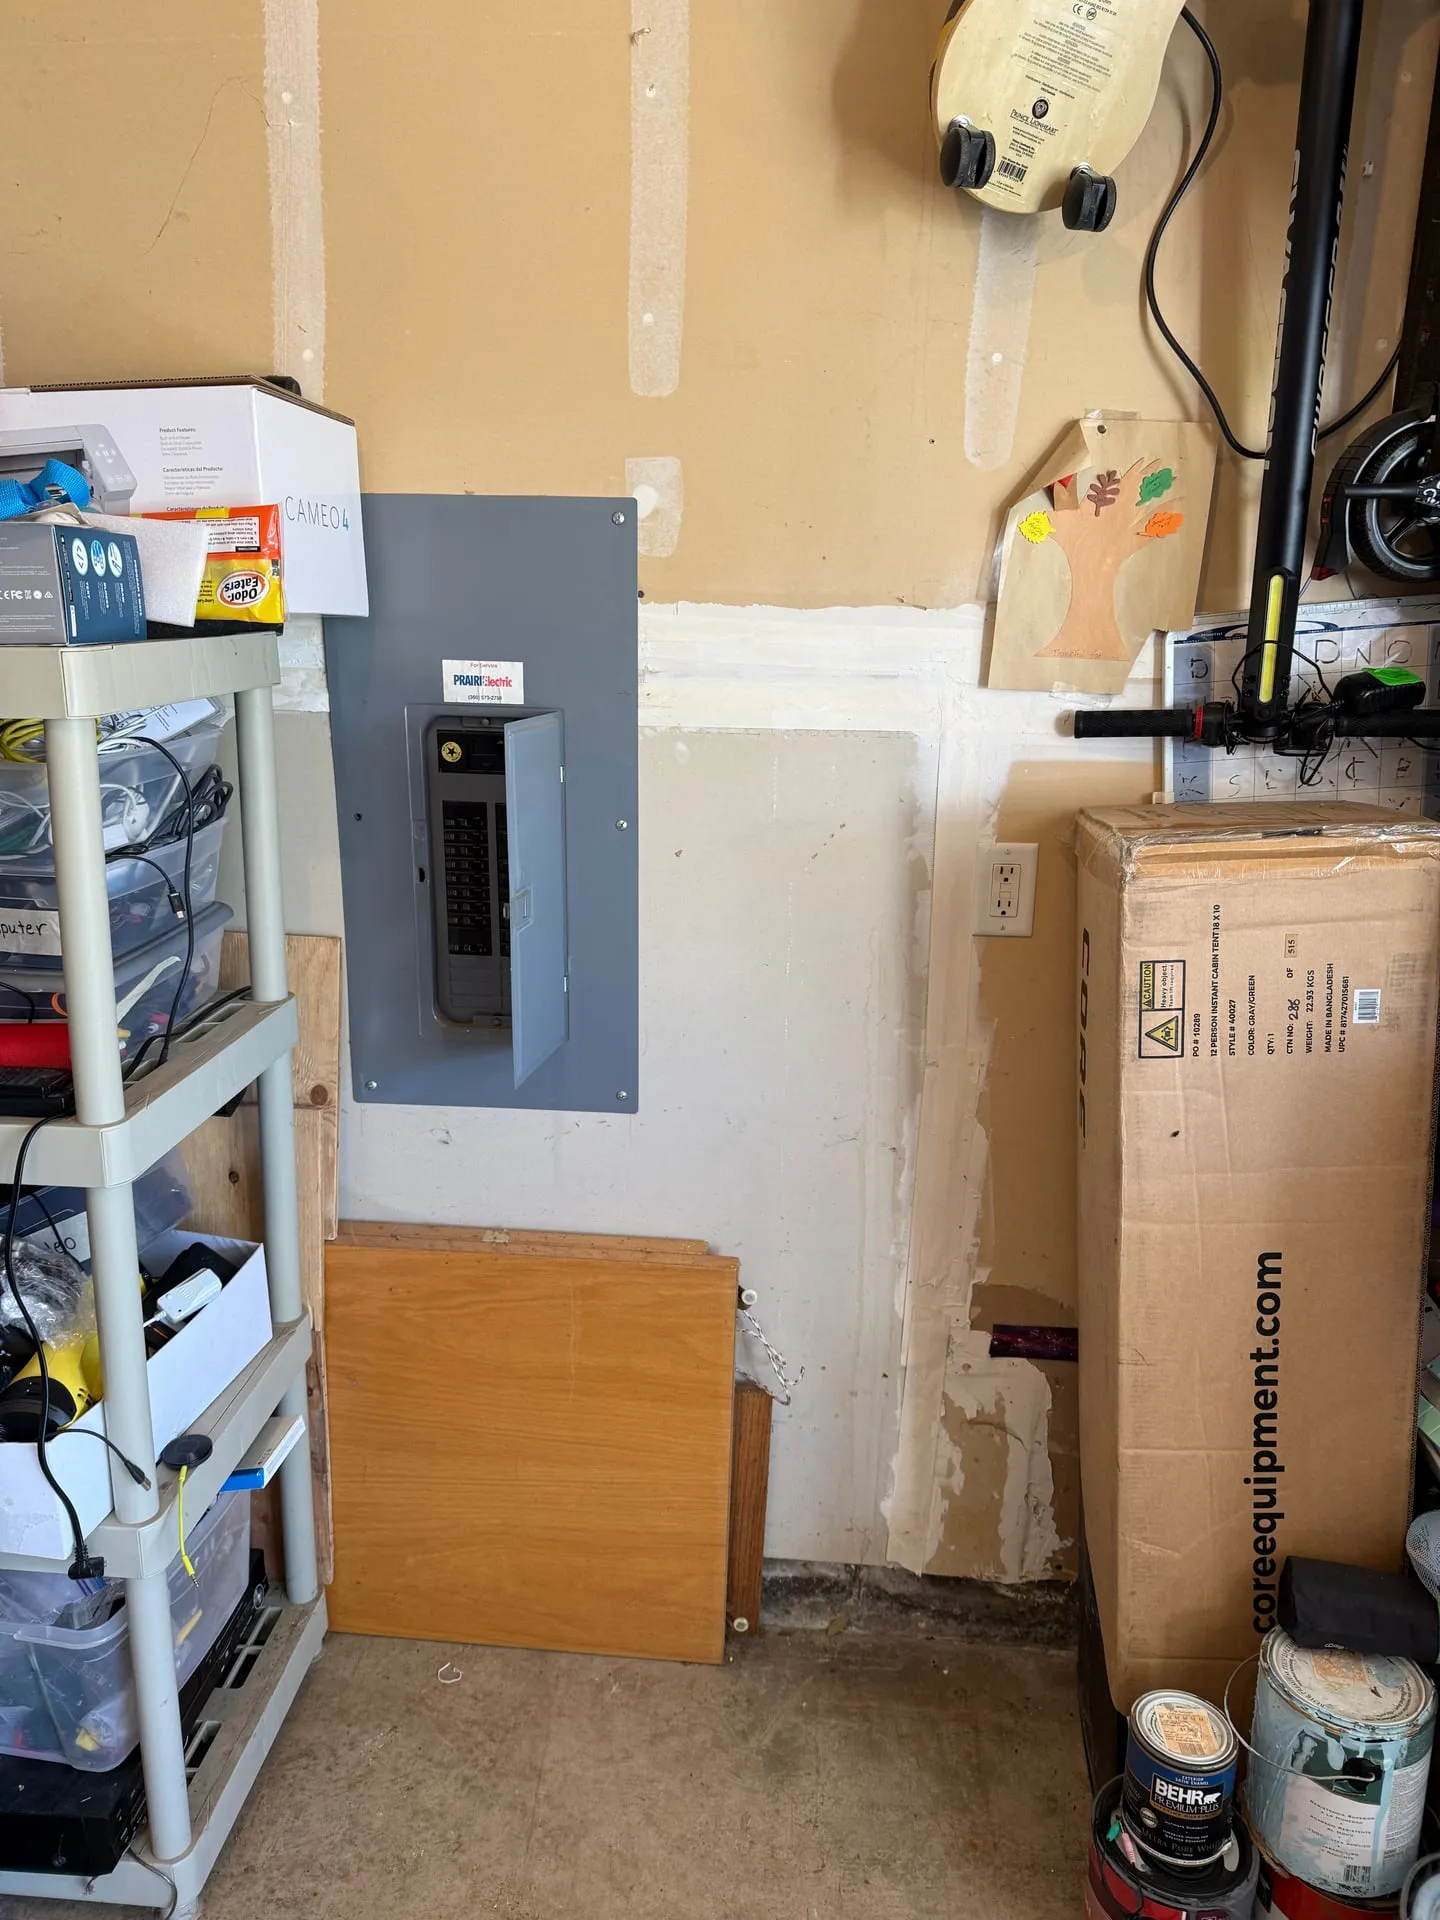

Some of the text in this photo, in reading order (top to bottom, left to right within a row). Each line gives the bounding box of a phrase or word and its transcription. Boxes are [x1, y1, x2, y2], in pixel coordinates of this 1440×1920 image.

[224, 576, 258, 592] Eaters
[227, 588, 258, 602] Odor-
[1213, 905, 1220, 913] 10
[1287, 968, 1293, 978] OF
[1144, 964, 1152, 999] CAUTION
[1248, 975, 1256, 1025] GRAY/GREEN
[1340, 976, 1349, 1028] 817427015681
[1326, 1019, 1332, 1028] IN
[1193, 1046, 1199, 1057] PO
[1210, 1049, 1218, 1057] 12
[1245, 1251, 1285, 1634] coreequipment.com
[1155, 1779, 1203, 1805] BEHR
[1154, 1795, 1220, 1814] PREMIUM PLUS
[1171, 1842, 1193, 1853] PURE
